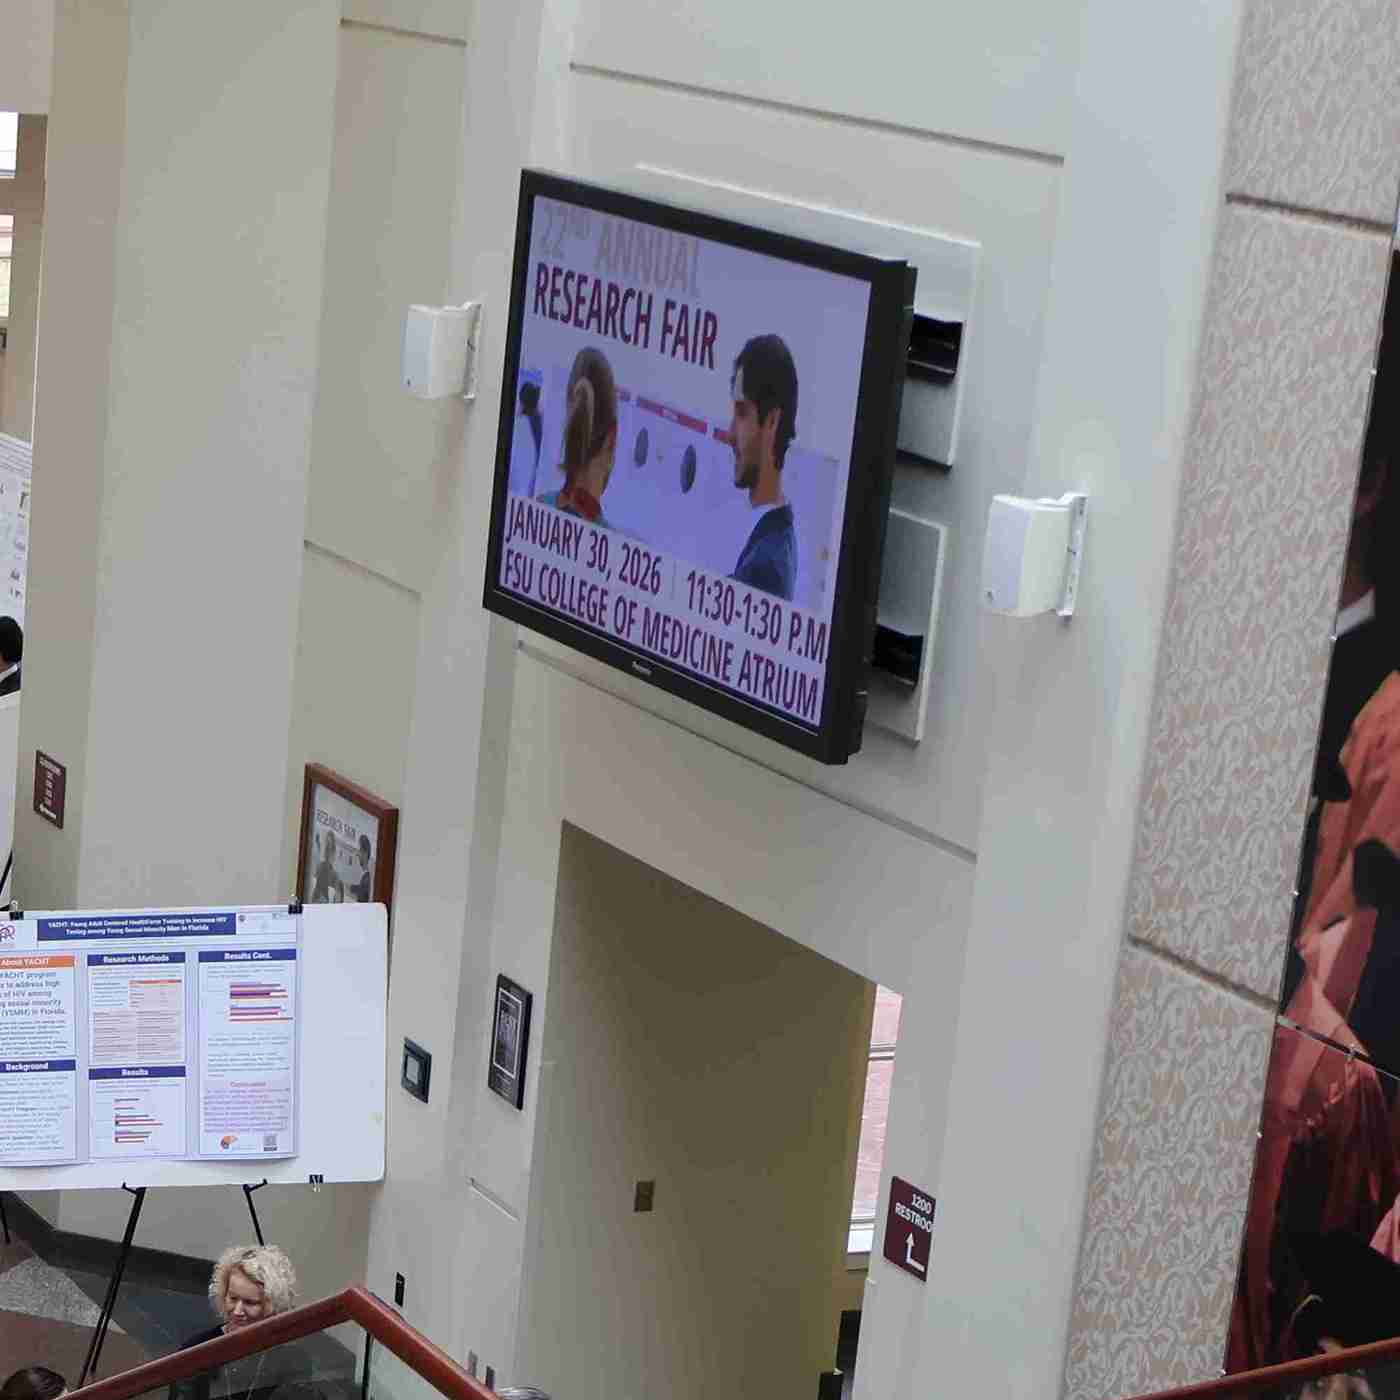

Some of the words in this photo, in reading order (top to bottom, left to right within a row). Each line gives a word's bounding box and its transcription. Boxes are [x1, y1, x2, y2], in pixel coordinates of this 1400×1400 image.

[533, 262, 651, 349] RESEARCH
[660, 299, 718, 370] FAIR
[504, 497, 583, 559] JANUARY
[589, 530, 611, 581] 30,
[620, 542, 662, 596] 2026
[686, 570, 783, 652] 11:30-1:30
[504, 549, 534, 594] FSU
[538, 563, 608, 628] COLLEGE
[613, 593, 637, 638] OF
[642, 605, 731, 685] MEDICINE
[737, 648, 820, 722] ATRIUM
[23, 958, 49, 966] YACHT
[103, 955, 137, 964] Research
[138, 953, 170, 963] Methods
[224, 952, 251, 960] Results
[5, 1062, 49, 1072] Background
[912, 1193, 932, 1216] 1200
